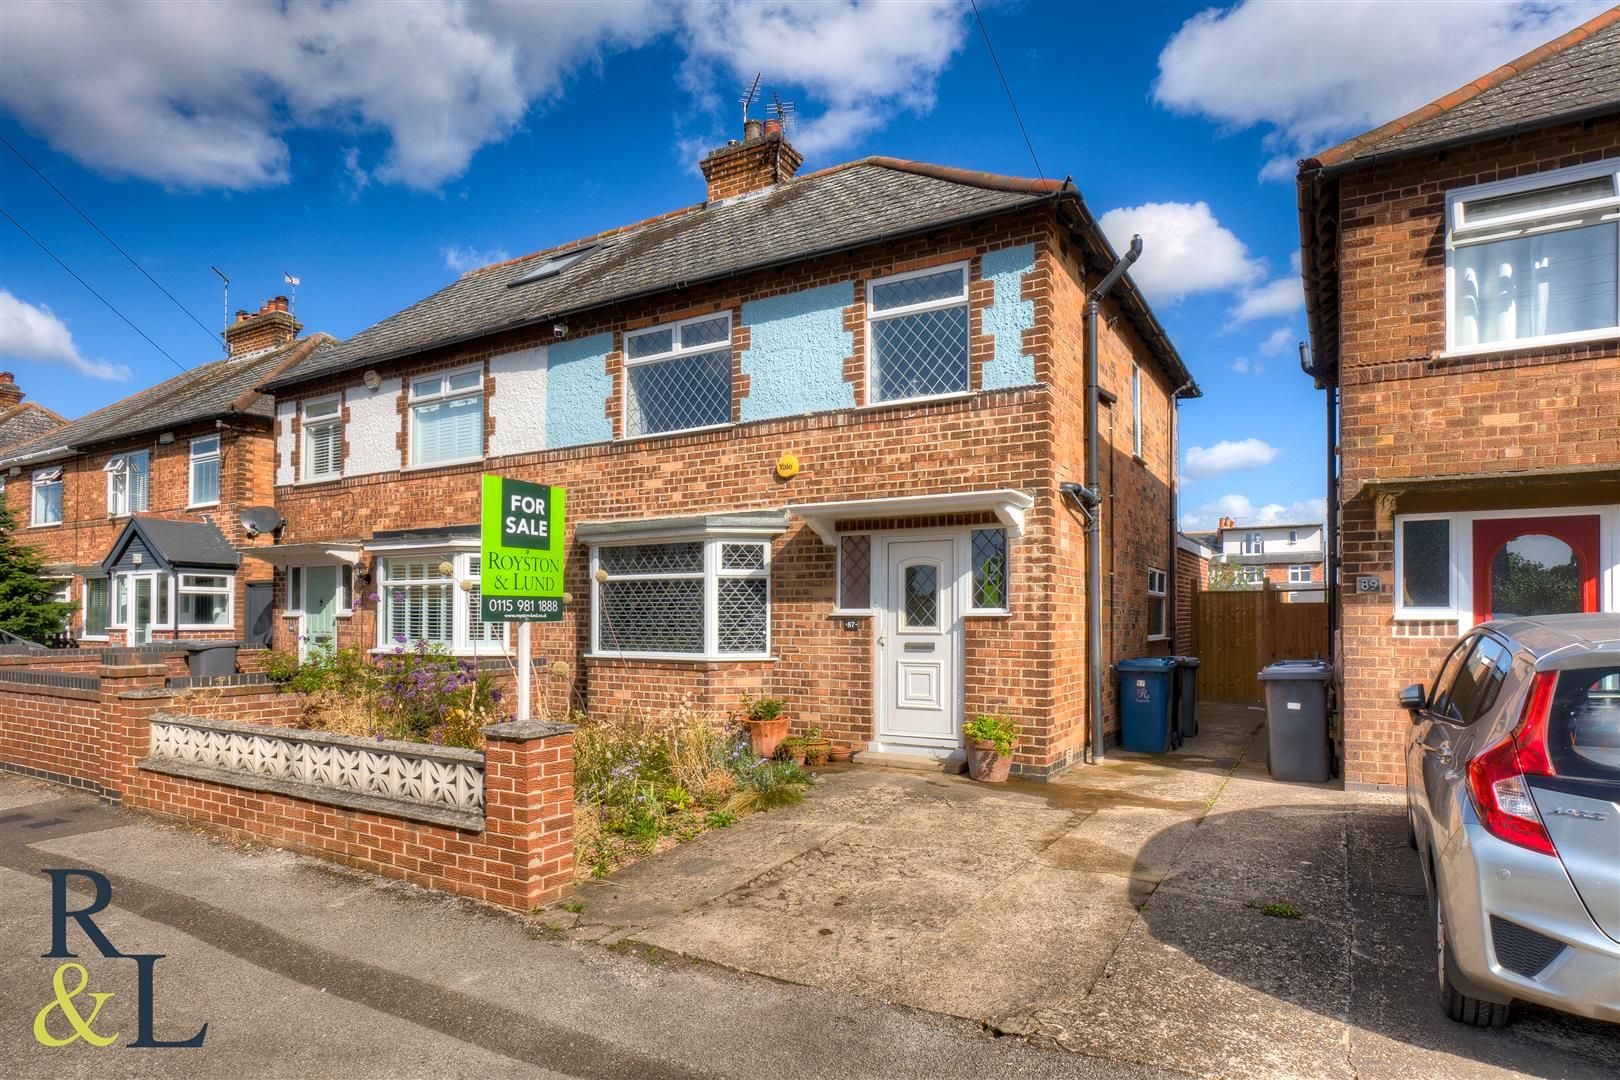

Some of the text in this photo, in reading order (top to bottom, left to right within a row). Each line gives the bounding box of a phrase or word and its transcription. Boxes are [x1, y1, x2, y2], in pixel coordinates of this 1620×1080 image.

[511, 495, 545, 515] FOR
[505, 516, 548, 537] SALE
[488, 551, 560, 573] ROYSTON
[494, 572, 555, 592] & LUND
[1361, 579, 1378, 591] 89
[489, 599, 558, 612] 0115 981 1888
